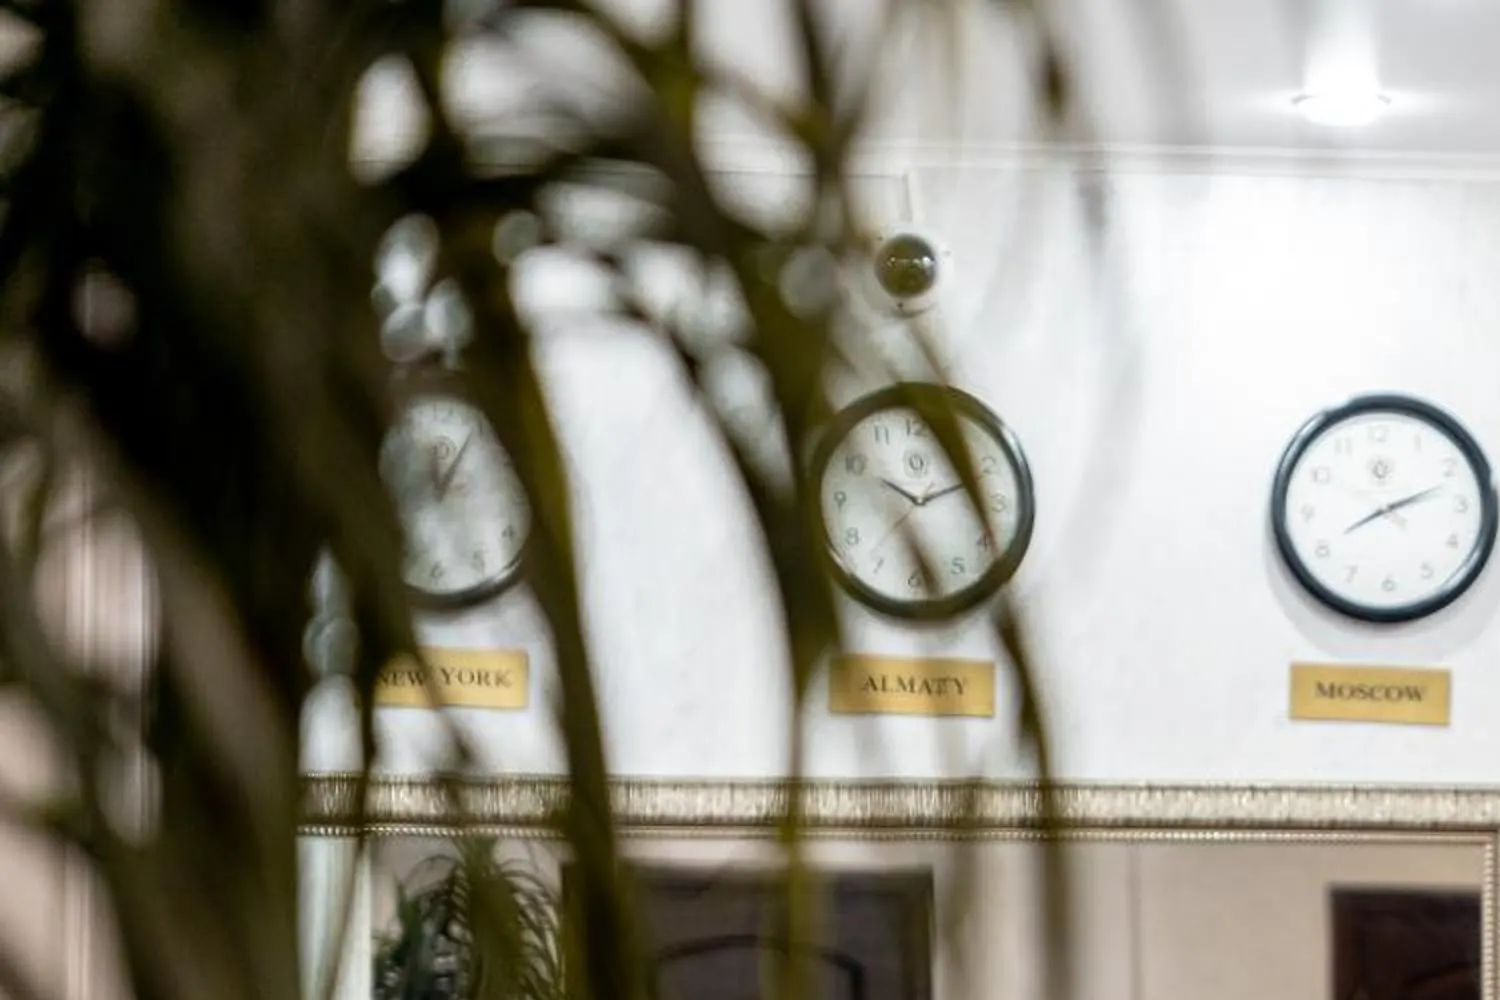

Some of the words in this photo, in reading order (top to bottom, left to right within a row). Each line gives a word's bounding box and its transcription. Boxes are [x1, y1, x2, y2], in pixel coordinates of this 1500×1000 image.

[873, 425, 890, 445] 11
[906, 418, 929, 437] 12
[1368, 425, 1389, 442] 12
[1336, 438, 1352, 455] 11
[1414, 434, 1421, 450] 1
[845, 454, 866, 475] 10
[982, 457, 997, 473] 2
[1442, 459, 1458, 477] 2
[1312, 466, 1331, 484] 10
[834, 491, 846, 509] 9
[992, 494, 1006, 512] 3
[1457, 497, 1469, 514] 3
[1302, 505, 1314, 522] 9
[846, 529, 860, 545] 8
[1446, 534, 1459, 550] 4
[1315, 542, 1330, 559] 8
[951, 558, 964, 575] 5
[1345, 566, 1358, 583] 7
[1421, 564, 1434, 580] 5
[908, 569, 921, 588] 6
[1382, 575, 1396, 592] 6
[378, 668, 426, 687] NEW
[441, 667, 513, 688] YORK
[862, 674, 967, 695] ALMATY
[1315, 681, 1426, 702] MOSCOW
